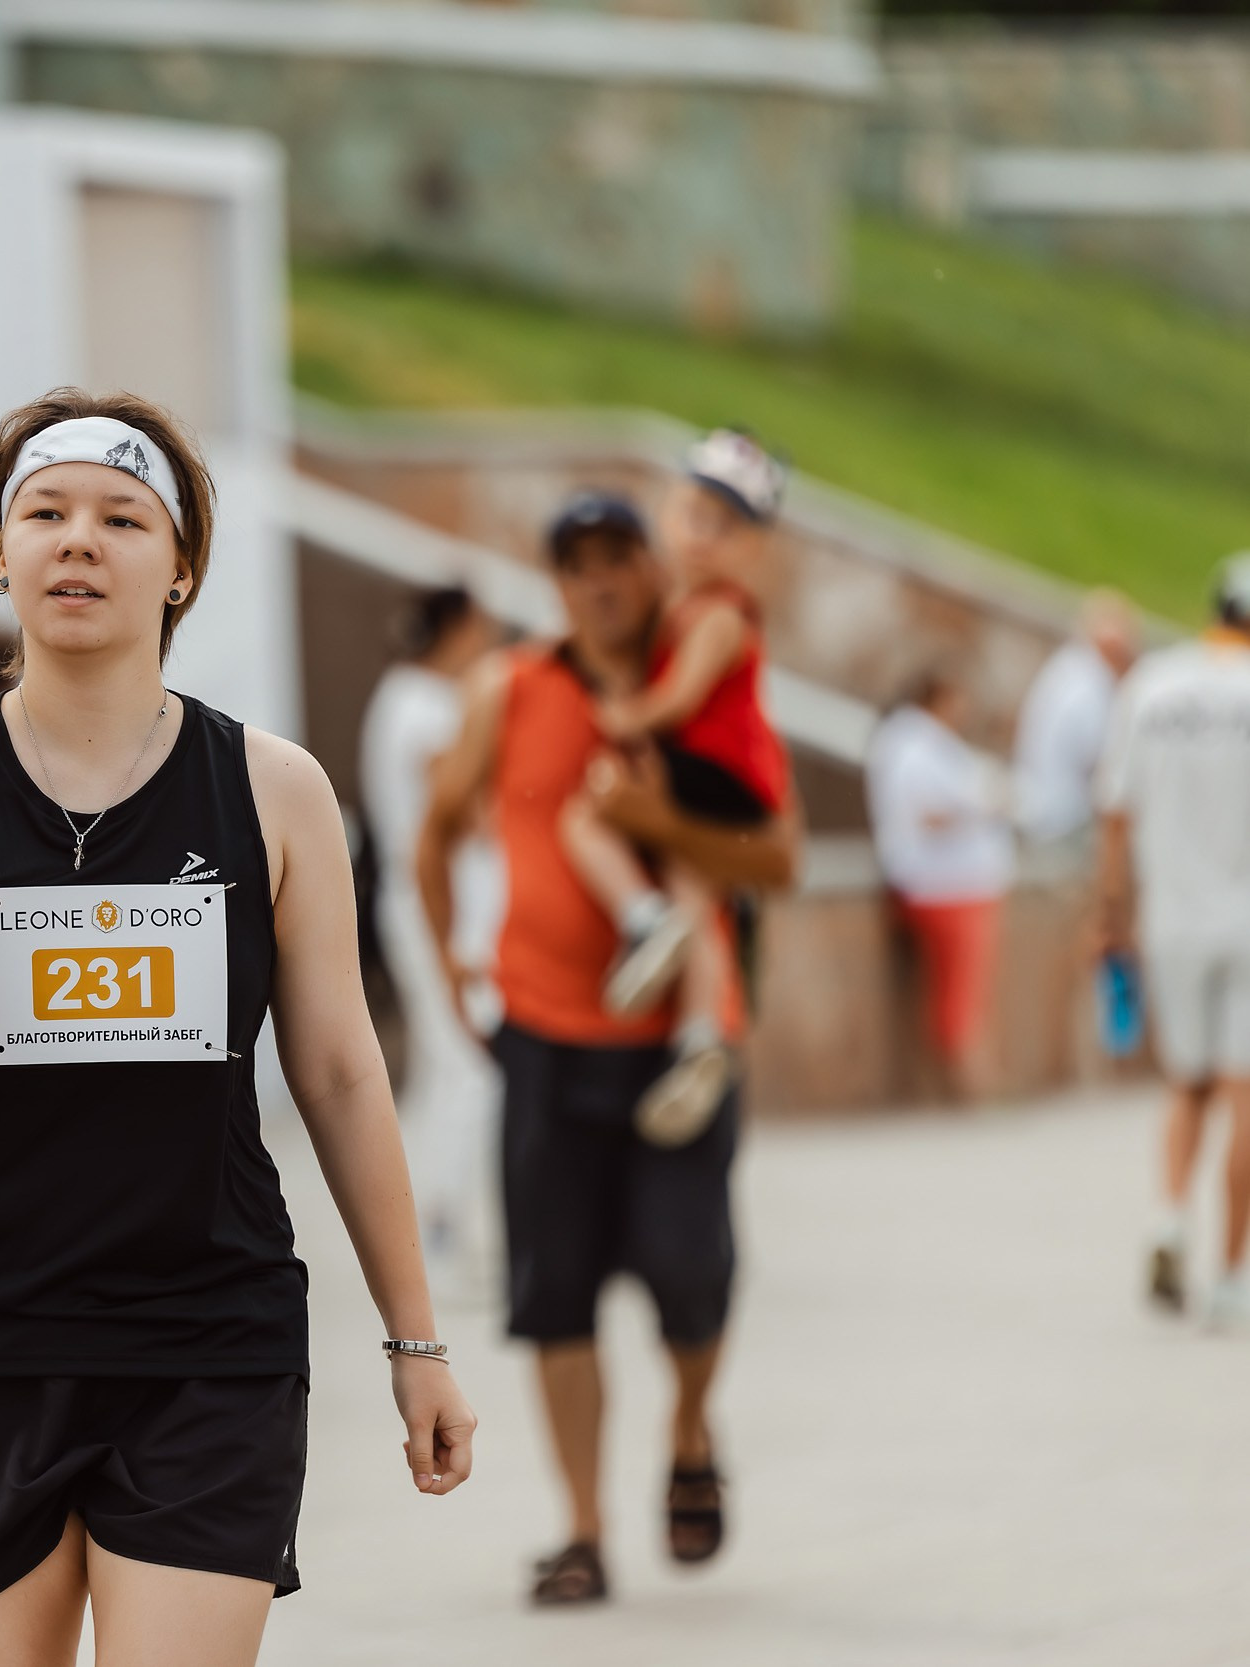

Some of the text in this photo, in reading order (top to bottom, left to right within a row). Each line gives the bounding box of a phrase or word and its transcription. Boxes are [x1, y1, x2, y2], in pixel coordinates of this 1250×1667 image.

[169, 868, 219, 885] DEMIX
[0, 908, 202, 931] LEONE D'ORO
[47, 955, 152, 1010] 231
[7, 1027, 203, 1045] БЛАГОТВОРИТЕЛЬНЫЙ ЗАБЕГ
